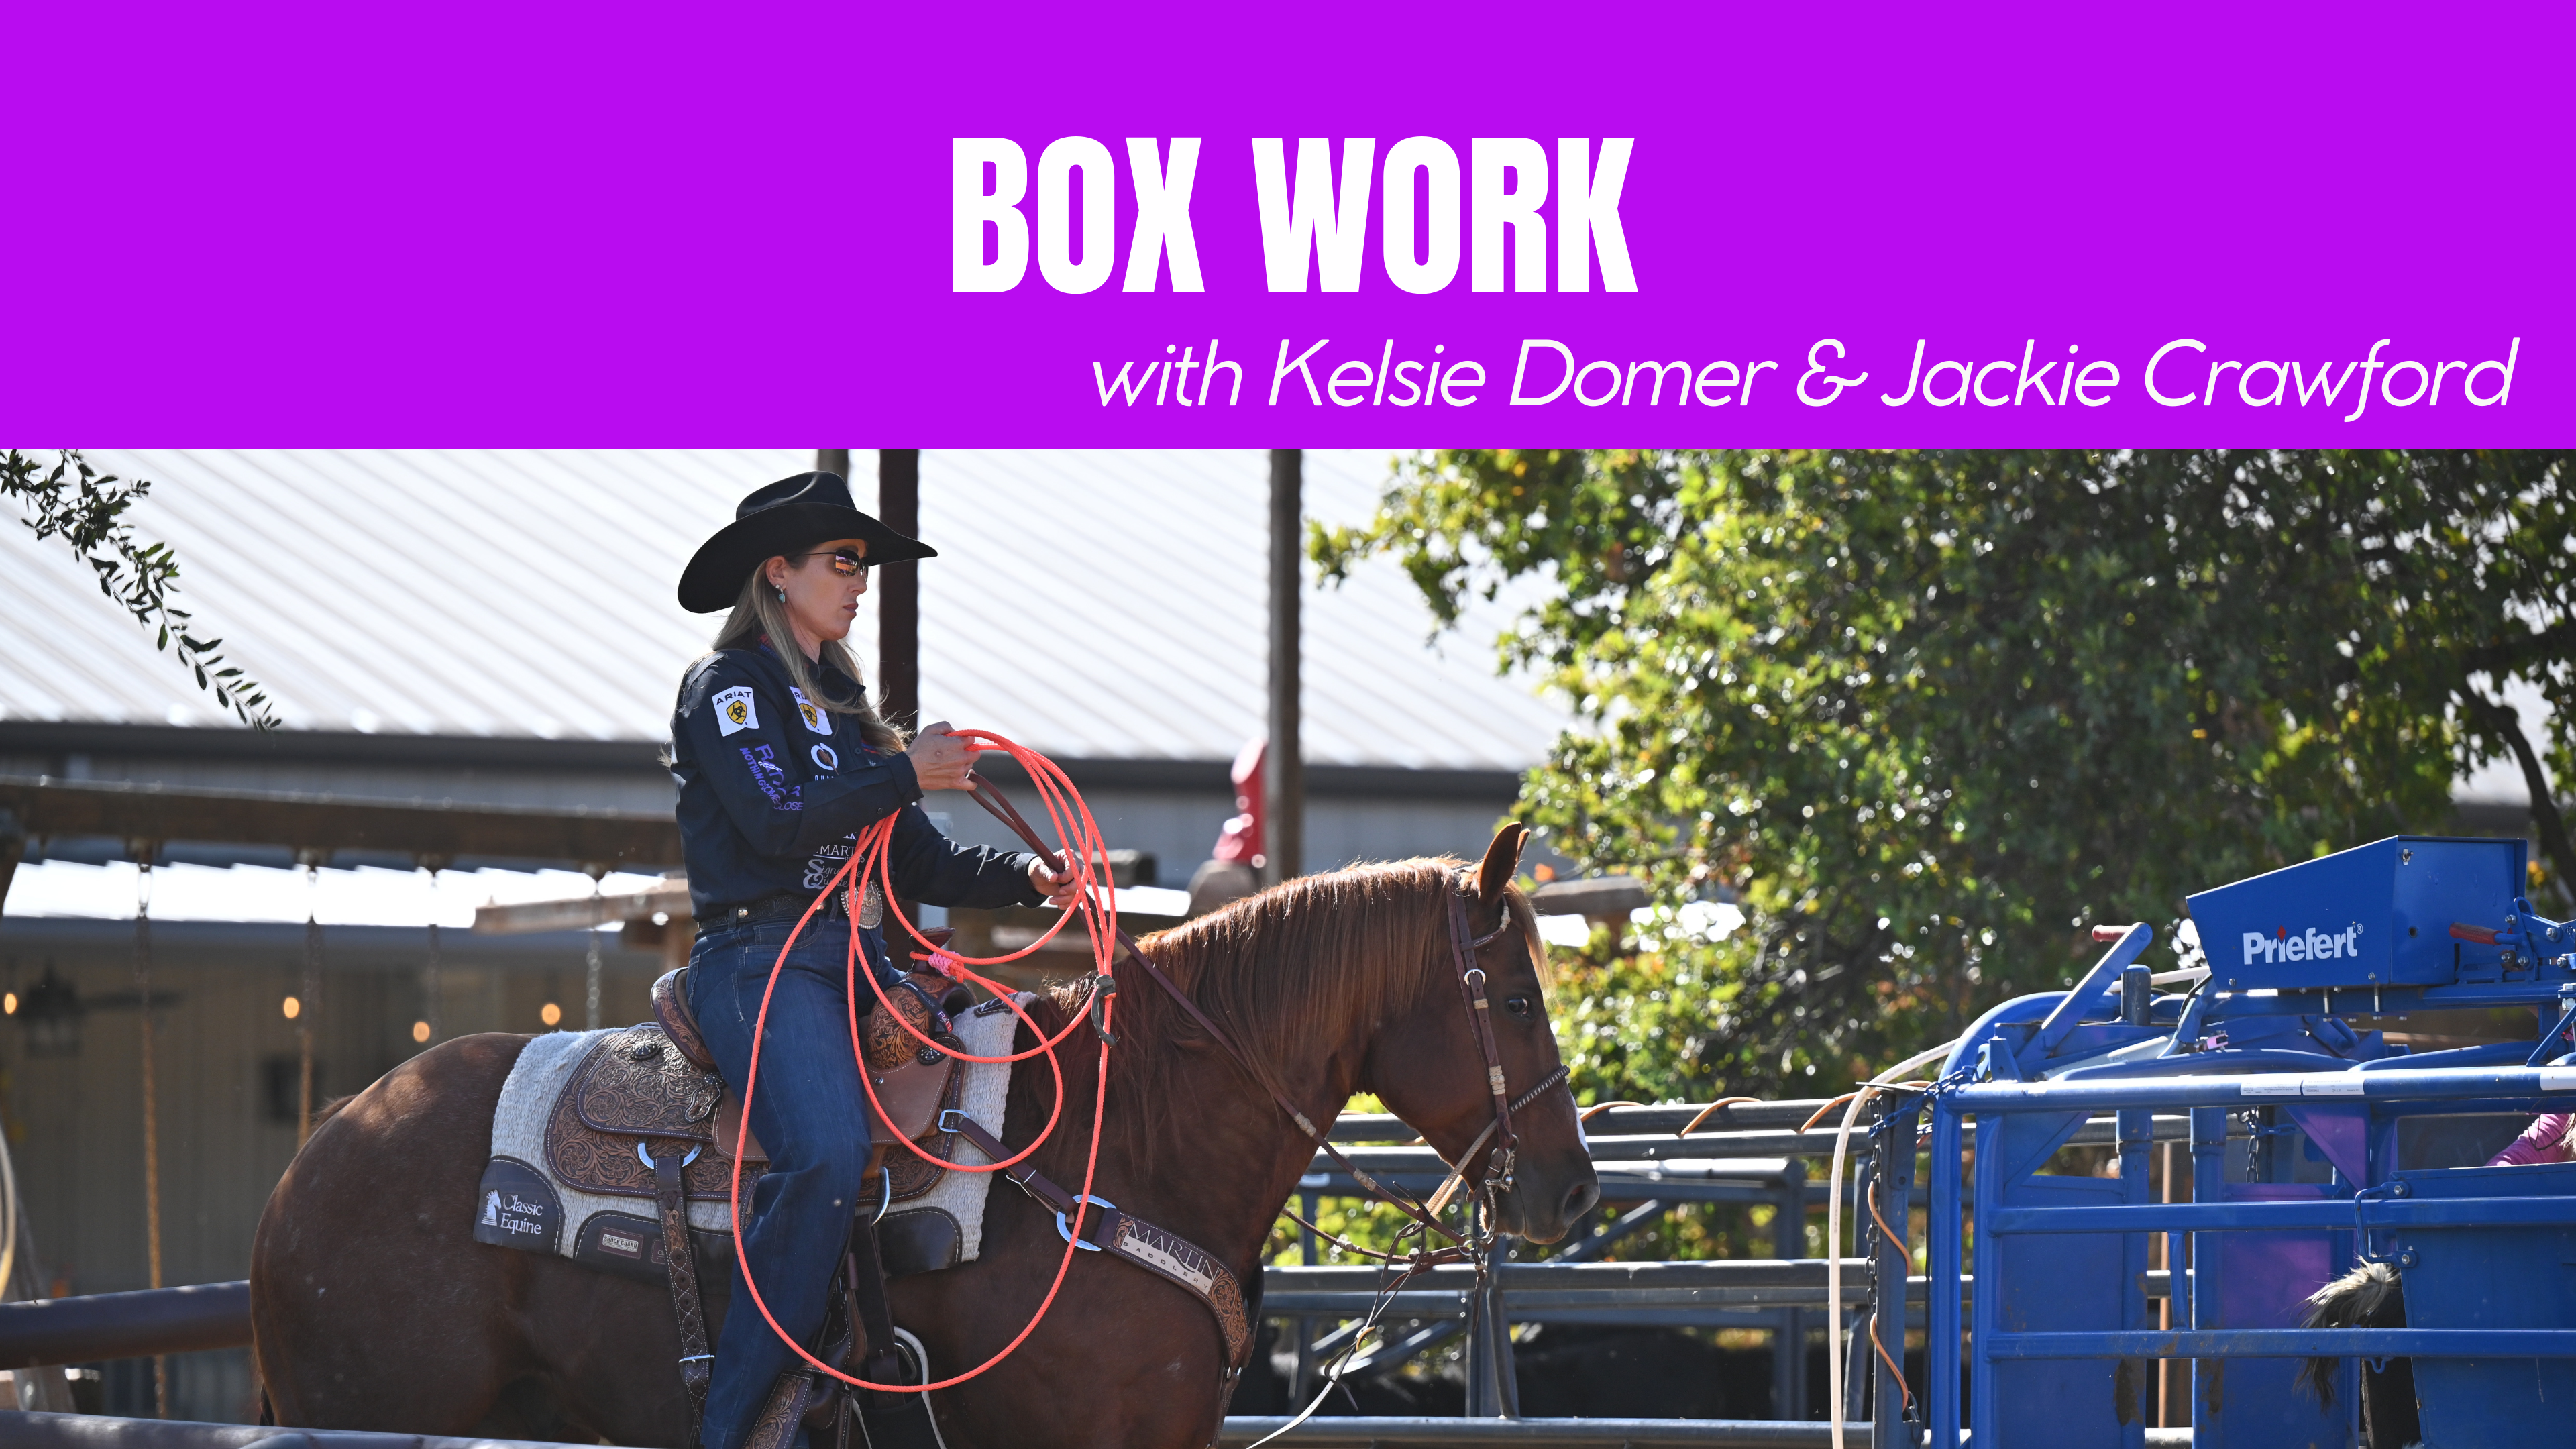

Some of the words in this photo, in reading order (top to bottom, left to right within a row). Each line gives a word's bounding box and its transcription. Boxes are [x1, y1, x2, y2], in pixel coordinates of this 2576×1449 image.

[716, 691, 752, 705] ARIAT
[739, 747, 766, 786] NOTHING
[761, 783, 781, 804] COME
[820, 845, 862, 857] MART
[503, 1194, 543, 1216] Classic
[500, 1212, 542, 1234] Equine
[604, 1236, 620, 1244] SHOCK
[1126, 1222, 1221, 1281] MARTIN
[1123, 1241, 1208, 1289] SADDLERY
